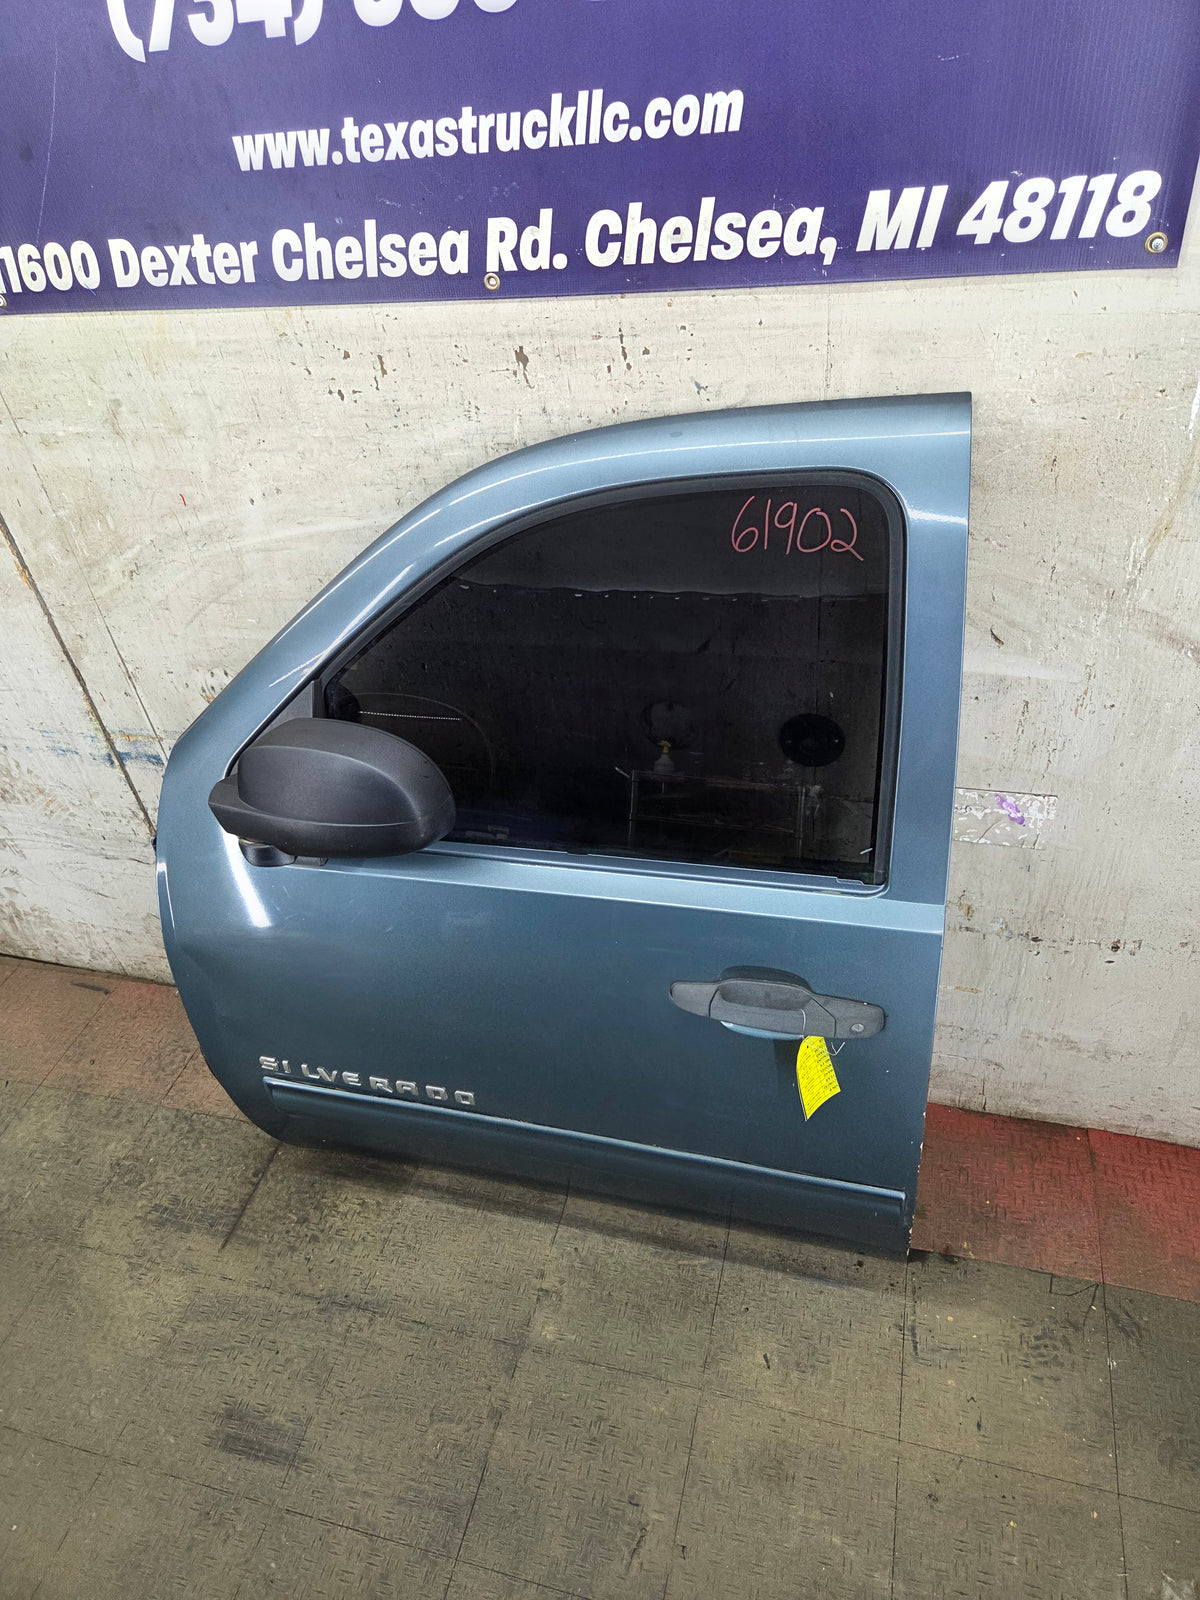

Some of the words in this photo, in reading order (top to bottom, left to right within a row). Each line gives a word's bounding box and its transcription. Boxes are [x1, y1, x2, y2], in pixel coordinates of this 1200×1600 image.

[232, 88, 745, 172] www.texastruckllc.com
[0, 240, 101, 293] 1600
[107, 233, 259, 289] Dexter
[271, 218, 470, 282] Chelsea
[486, 207, 568, 273] Rd.
[585, 196, 838, 268] Chelsea,
[856, 184, 950, 253] MI
[956, 168, 1163, 245] 48118
[731, 495, 865, 562] 61902
[258, 1055, 477, 1106] SILVERADO
